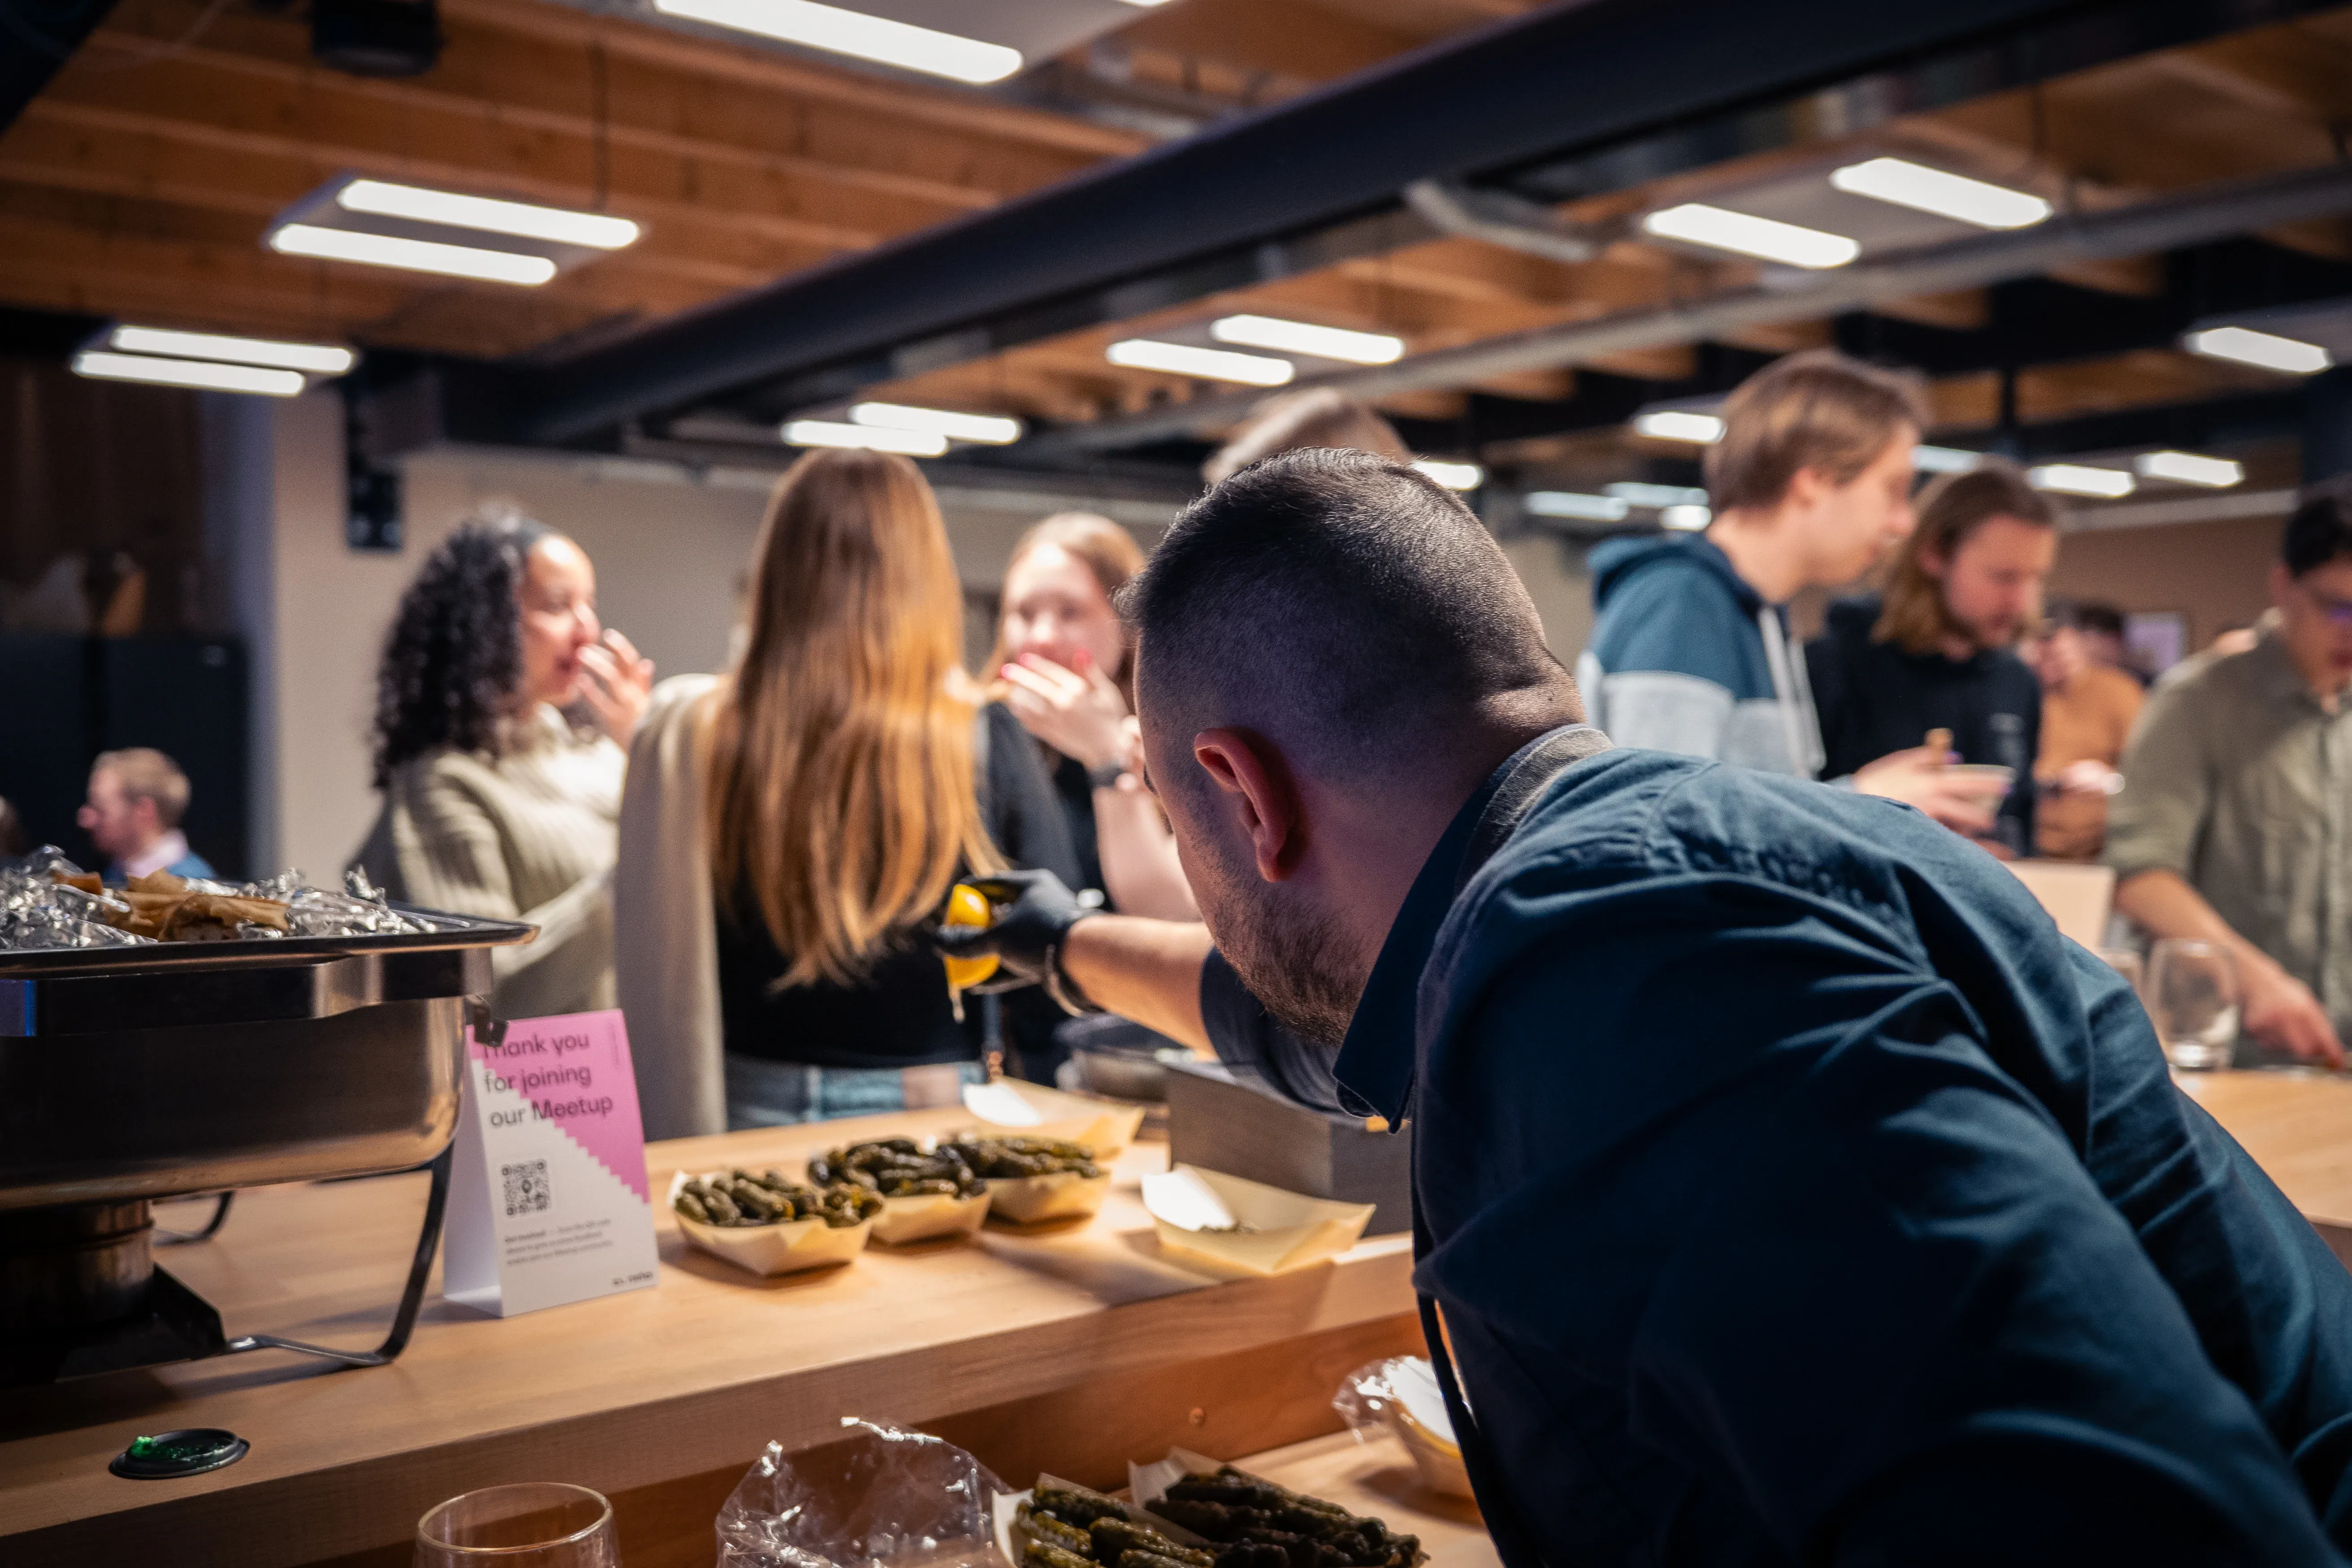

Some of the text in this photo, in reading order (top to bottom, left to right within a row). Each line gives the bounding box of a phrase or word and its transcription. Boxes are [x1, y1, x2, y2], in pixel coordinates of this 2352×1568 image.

[552, 1034, 590, 1056] you
[484, 1066, 592, 1094] for joining
[489, 1096, 614, 1127] our Meetup
